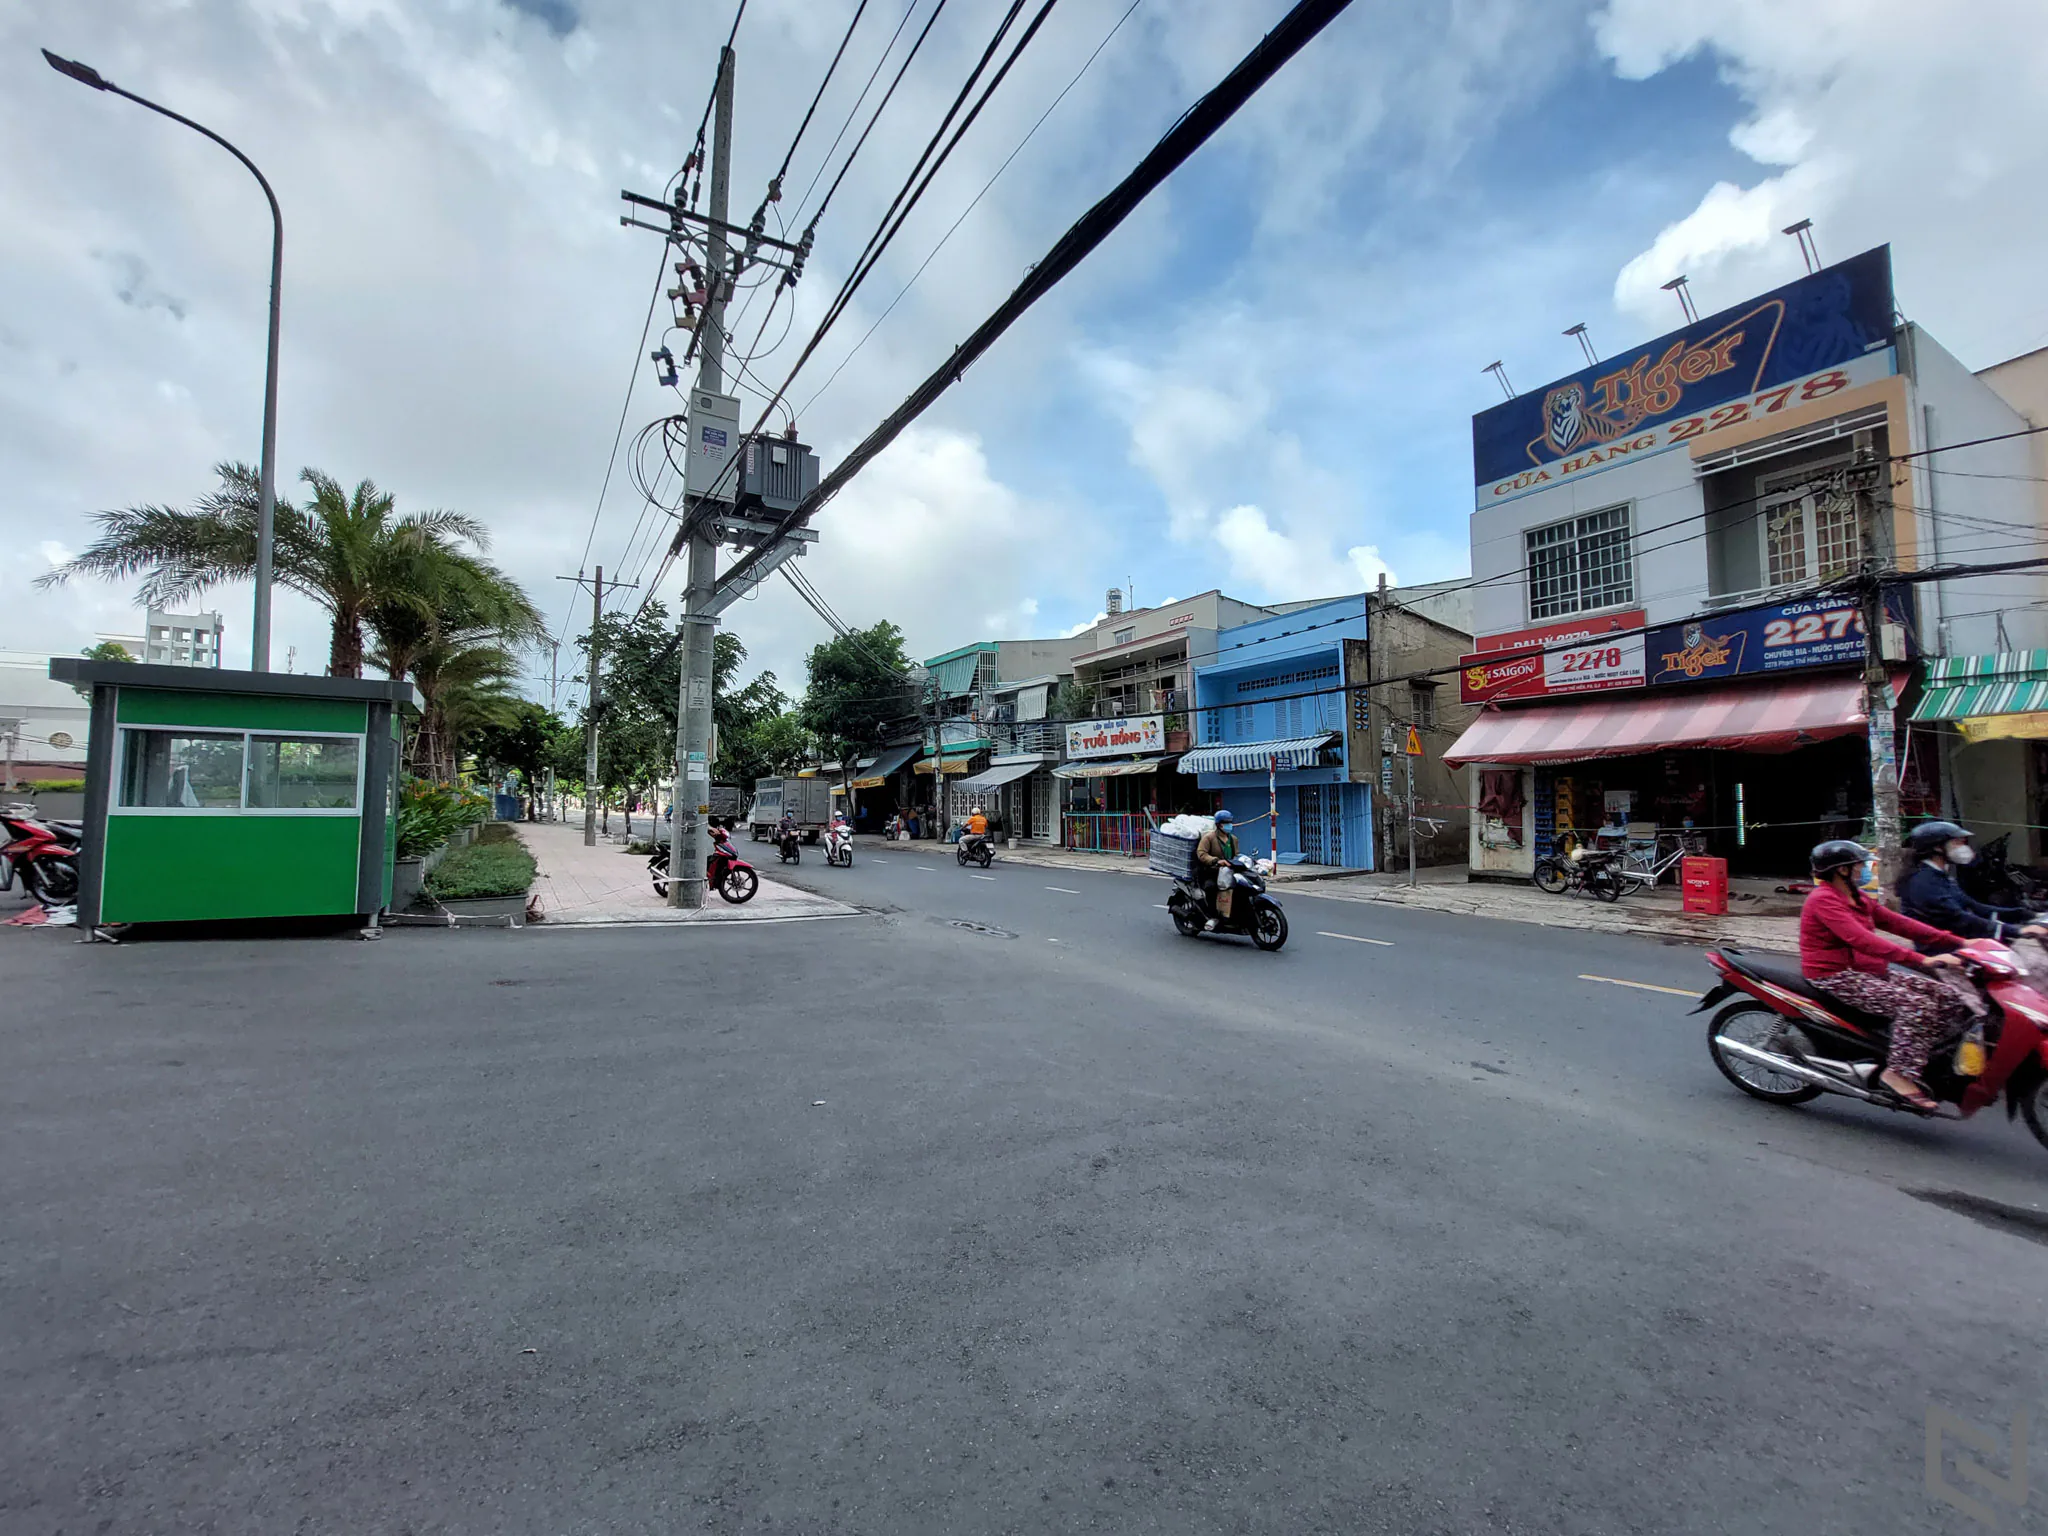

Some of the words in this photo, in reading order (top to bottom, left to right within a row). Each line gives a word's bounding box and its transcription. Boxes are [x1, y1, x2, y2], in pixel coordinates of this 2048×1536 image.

[1592, 332, 1746, 415] Tiger
[1494, 472, 1553, 496] CỬA
[1561, 434, 1657, 475] HÀNG
[1668, 370, 1852, 445] 2278
[1562, 647, 1621, 672] 2278
[1661, 643, 1731, 677] Tiger
[1795, 648, 1807, 656] BIA
[1492, 664, 1533, 678] SAIGON
[1082, 730, 1108, 749] TUỔI
